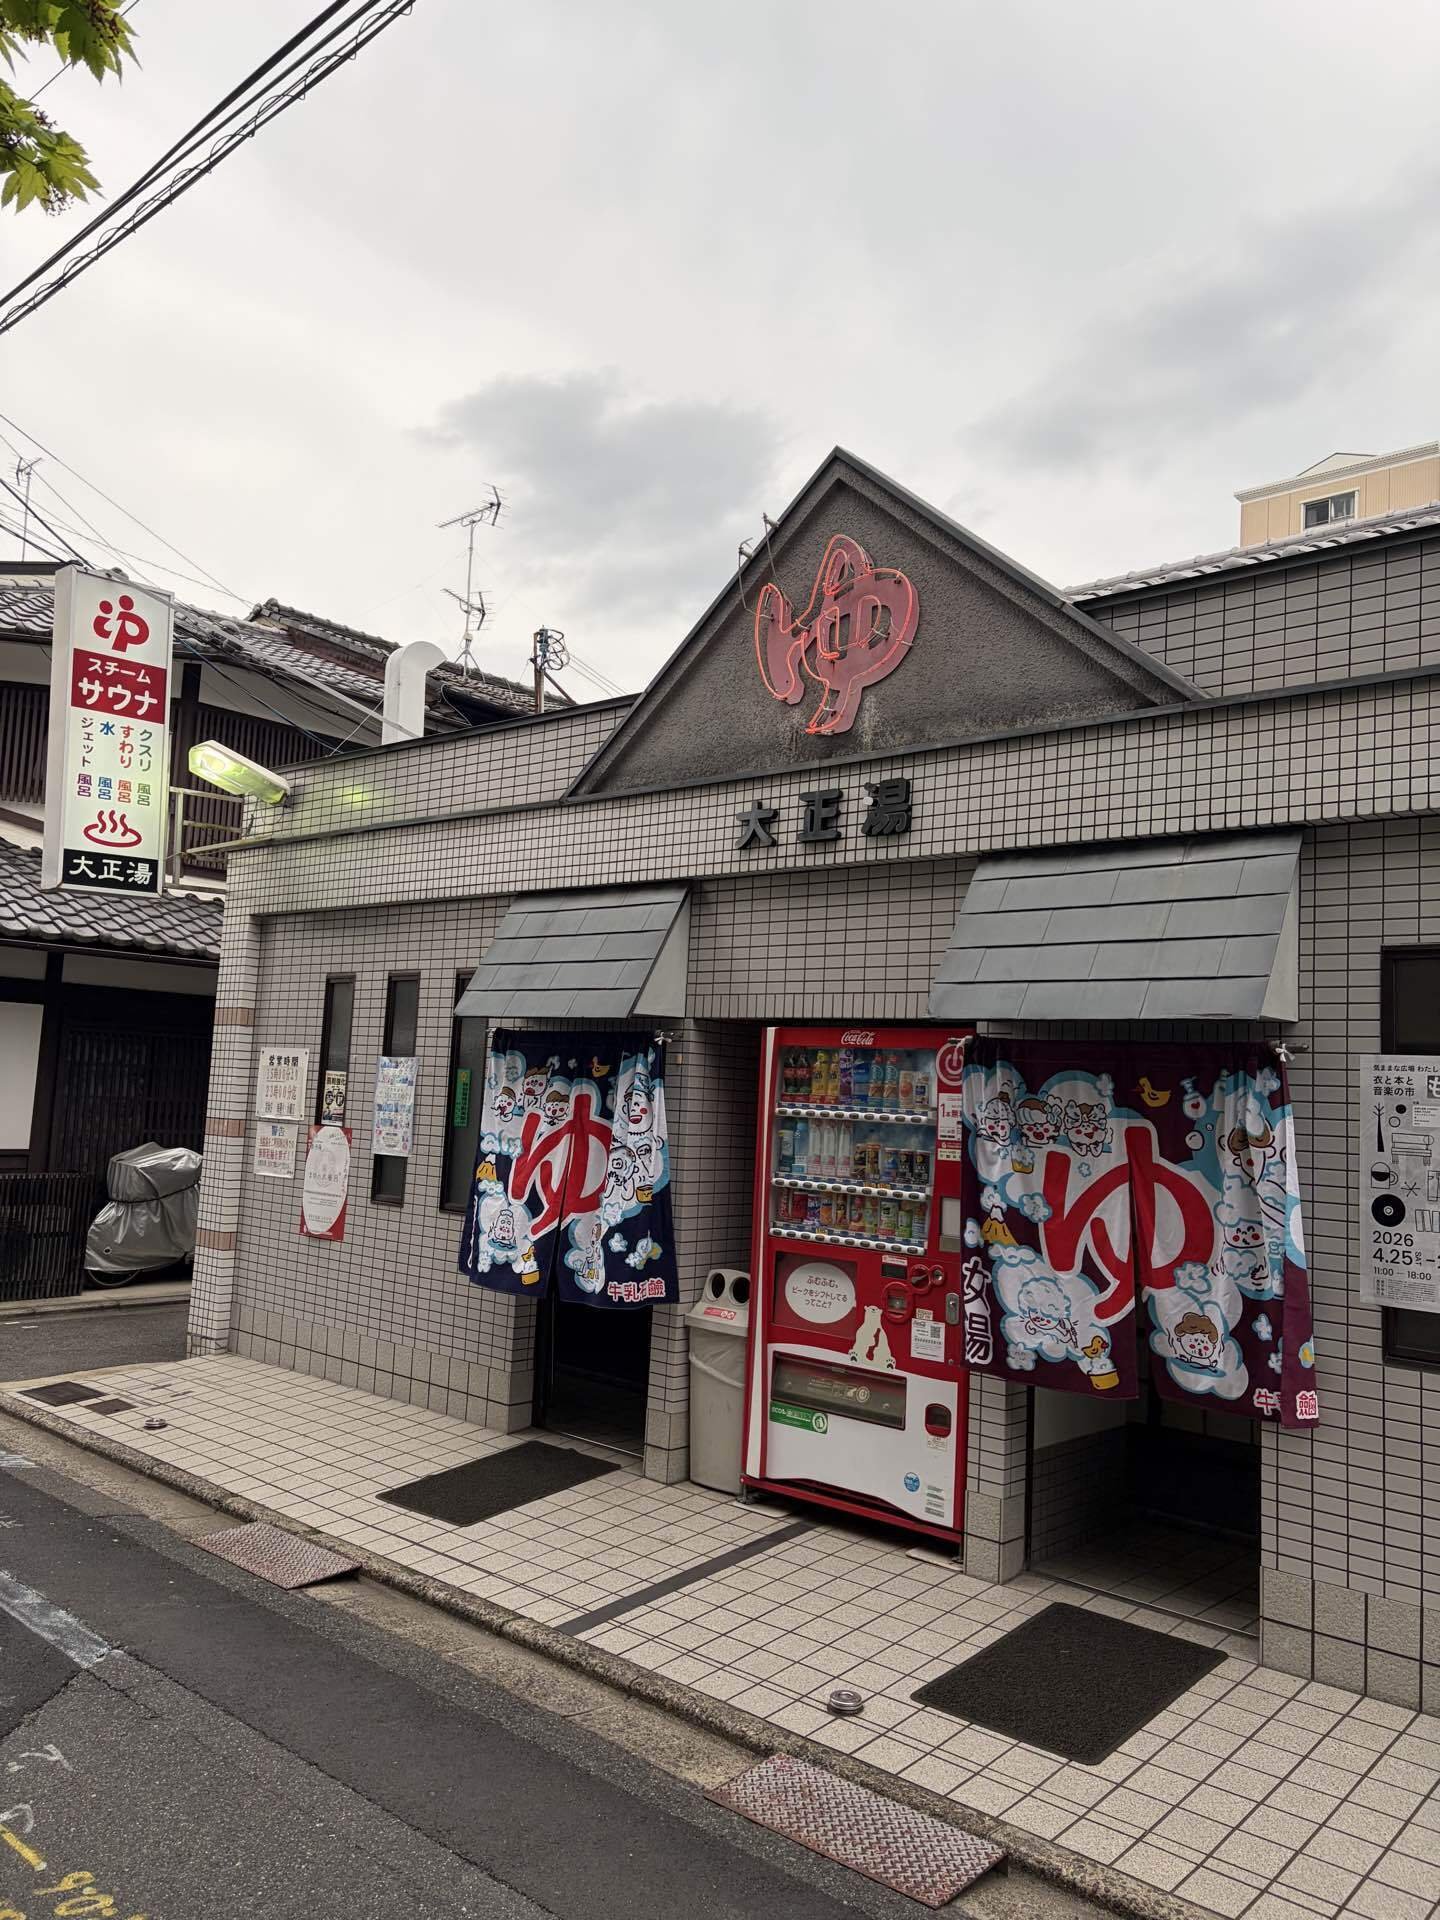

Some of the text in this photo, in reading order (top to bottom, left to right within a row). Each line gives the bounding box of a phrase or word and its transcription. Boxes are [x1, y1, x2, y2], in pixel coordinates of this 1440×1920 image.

[87, 657, 152, 684] スチーム
[78, 676, 158, 716] サウナ
[76, 716, 95, 798] ジェット 風呂
[97, 720, 115, 801] 水 風呂
[117, 724, 135, 804] すわり 風呂
[136, 728, 153, 807] クスリ 風呂
[735, 777, 912, 850] 大正湯
[69, 856, 153, 885] 大正湯
[268, 1054, 299, 1067] 営業時間
[1373, 1075, 1414, 1085] 衣と本と
[1373, 1086, 1415, 1097] 音楽の市
[511, 1093, 613, 1237] ゆ
[1043, 1125, 1215, 1319] ゆ
[1372, 1230, 1414, 1247] 2026
[1372, 1247, 1413, 1265] 4.25
[1374, 1266, 1432, 1281] 11:00 18:00
[792, 1285, 848, 1303] ピークをシフトしてる
